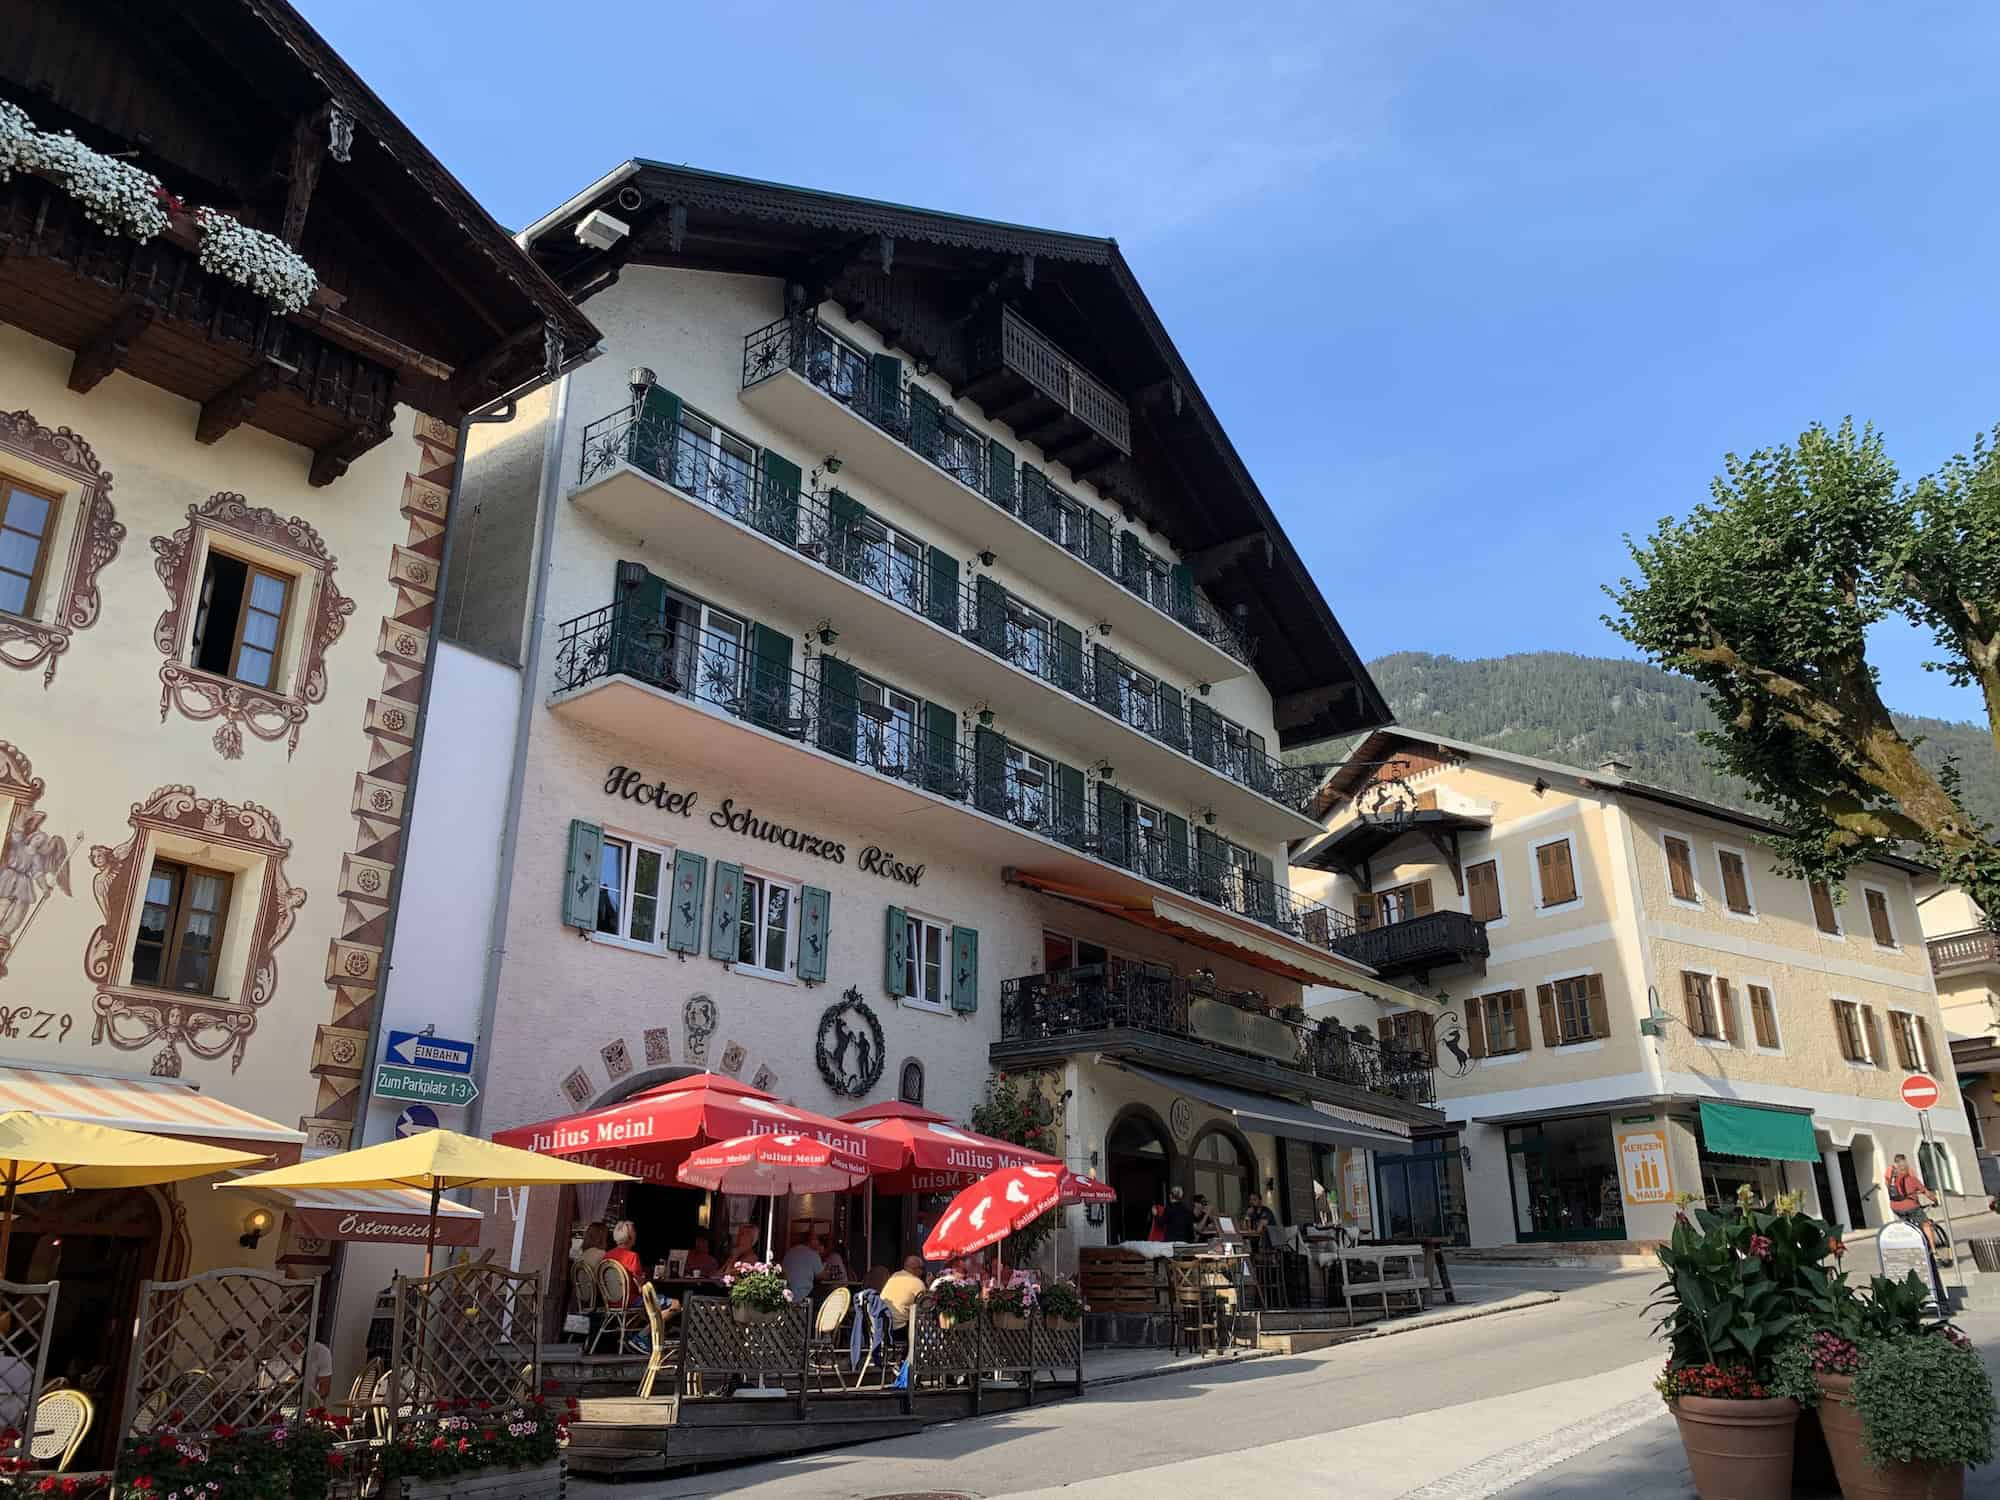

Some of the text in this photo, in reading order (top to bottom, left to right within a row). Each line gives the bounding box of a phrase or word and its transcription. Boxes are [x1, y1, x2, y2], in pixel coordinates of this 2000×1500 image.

[604, 765, 925, 887] Hotel Schwarzes Rössl
[415, 1046, 460, 1061] EINBAHN
[379, 1073, 466, 1097] Zum Parkplatz 1-3
[528, 1116, 654, 1153] Julius Meinl
[816, 1130, 868, 1157] Meinl
[759, 1151, 826, 1163] Julius Meinl
[947, 1147, 993, 1169] Julius
[1624, 1143, 1664, 1153] KERZEN
[1636, 1190, 1665, 1200] HAUS
